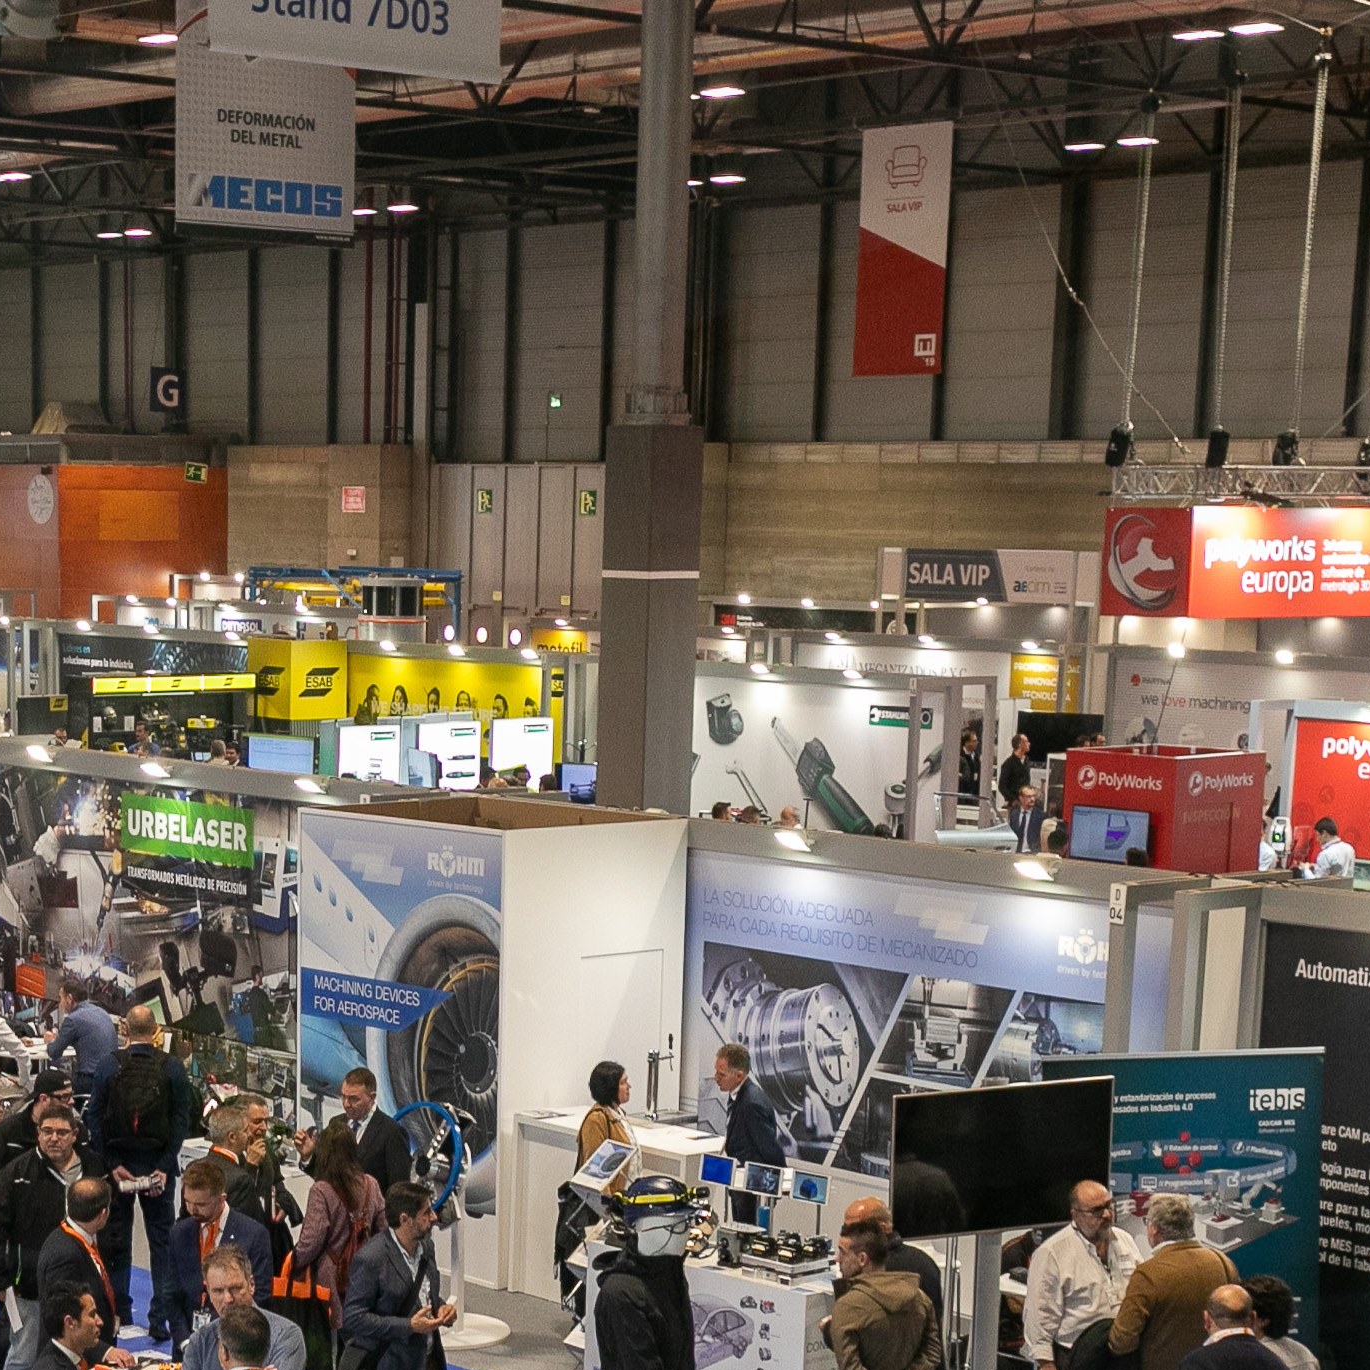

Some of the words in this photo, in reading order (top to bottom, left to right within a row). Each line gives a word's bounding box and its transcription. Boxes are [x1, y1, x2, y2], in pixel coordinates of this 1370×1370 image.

[217, 108, 316, 132] DEFORMACIÓN
[231, 129, 256, 144] DEL
[259, 131, 303, 149] METAL
[887, 203, 907, 213] SALA
[908, 202, 923, 211] VIP
[156, 374, 179, 407] G
[1204, 534, 1316, 569] polyworks
[909, 562, 955, 586] SALA
[959, 565, 990, 586] VIP
[1242, 570, 1314, 600] europa
[259, 674, 280, 688] ESAB
[306, 675, 333, 688] ESAB
[1141, 693, 1159, 706] we
[1161, 693, 1186, 707] love
[1189, 696, 1251, 714] machining
[1098, 772, 1163, 791] PolyWorks
[1205, 773, 1254, 792] PolyWorks
[127, 808, 248, 852] URBELASER
[127, 866, 174, 885] TRANSFORMADOS
[175, 873, 206, 890] METÁLICOS
[207, 879, 215, 891] DE
[216, 879, 247, 896] PRECISIÓN
[1115, 889, 1121, 901] D
[703, 888, 720, 905] LA
[722, 891, 795, 917] SOLUCIÓN
[798, 901, 874, 927] ADECUADA
[1109, 907, 1123, 920] 04
[702, 911, 737, 931] PARA
[739, 916, 778, 938] CADA
[781, 922, 853, 949] REQUISITO
[856, 935, 878, 953] DE
[880, 937, 979, 969] MECANIZADO
[314, 975, 372, 999] MACHINING
[375, 985, 420, 1007] DEVICES
[314, 996, 335, 1013] FOR
[337, 1002, 400, 1025] AEROSPACE
[1338, 1125, 1360, 1140] CAM
[1344, 1167, 1366, 1180] para
[1335, 1204, 1358, 1217] para
[1361, 1206, 1370, 1218] la
[1331, 1238, 1352, 1252] MES
[1328, 1254, 1341, 1265] de
[1342, 1256, 1351, 1267] la
